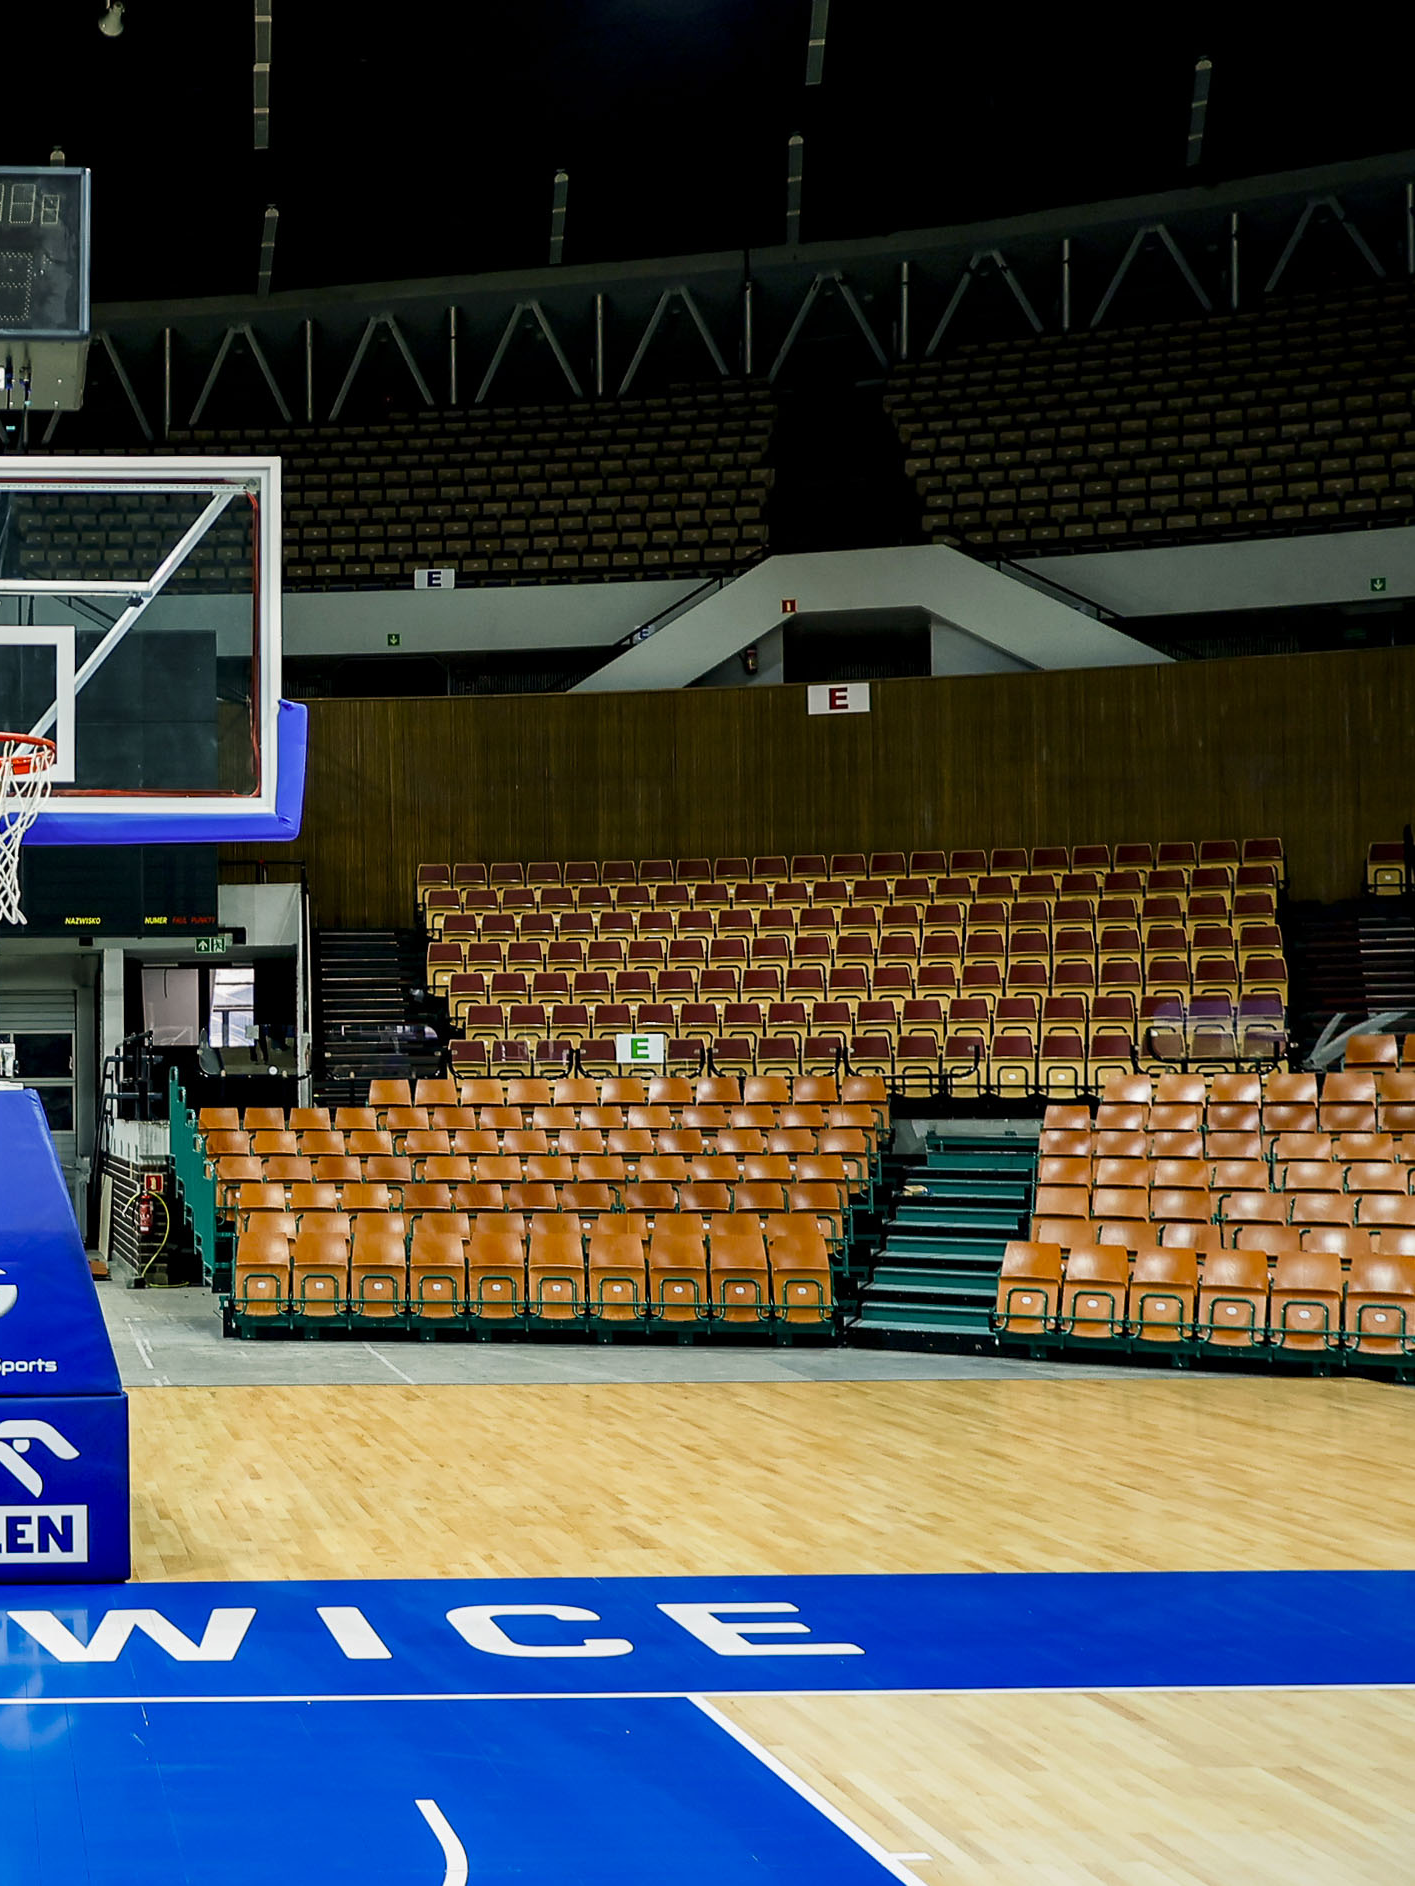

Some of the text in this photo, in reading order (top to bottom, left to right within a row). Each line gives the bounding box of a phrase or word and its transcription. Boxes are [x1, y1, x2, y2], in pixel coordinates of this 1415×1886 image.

[427, 571, 442, 587] E
[829, 688, 849, 710] E
[65, 916, 101, 925] NAZWISKO
[144, 916, 168, 925] NUMER
[191, 917, 217, 925] PUNKTY
[631, 1038, 649, 1059] E
